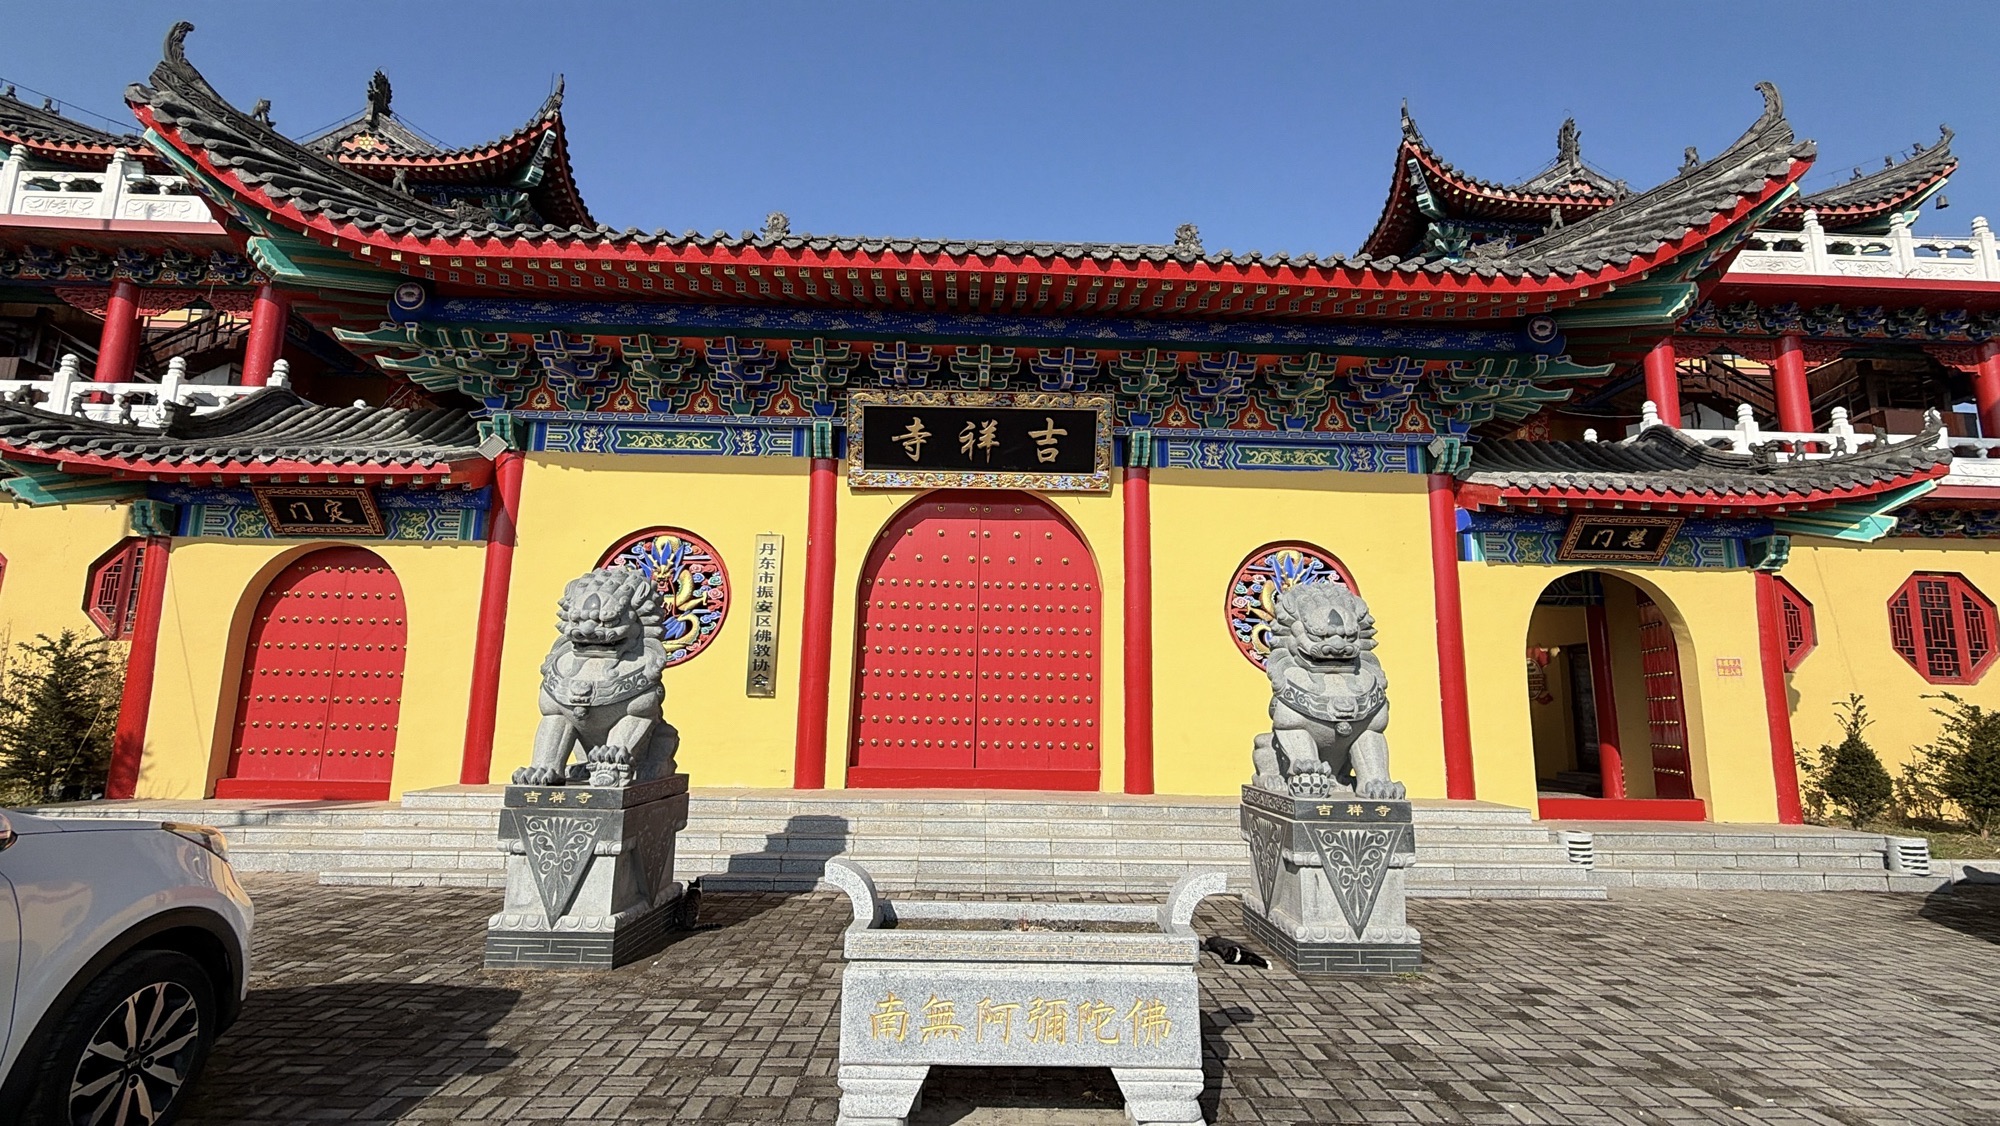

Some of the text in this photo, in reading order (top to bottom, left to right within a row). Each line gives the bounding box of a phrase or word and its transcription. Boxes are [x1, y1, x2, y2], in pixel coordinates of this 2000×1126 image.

[752, 543, 777, 687] 丹东市振安区佛教协会
[524, 790, 593, 804] 吉祥寺
[1316, 804, 1392, 817] 吉祥寺
[870, 991, 1173, 1048] 南無阿彌陀佛
